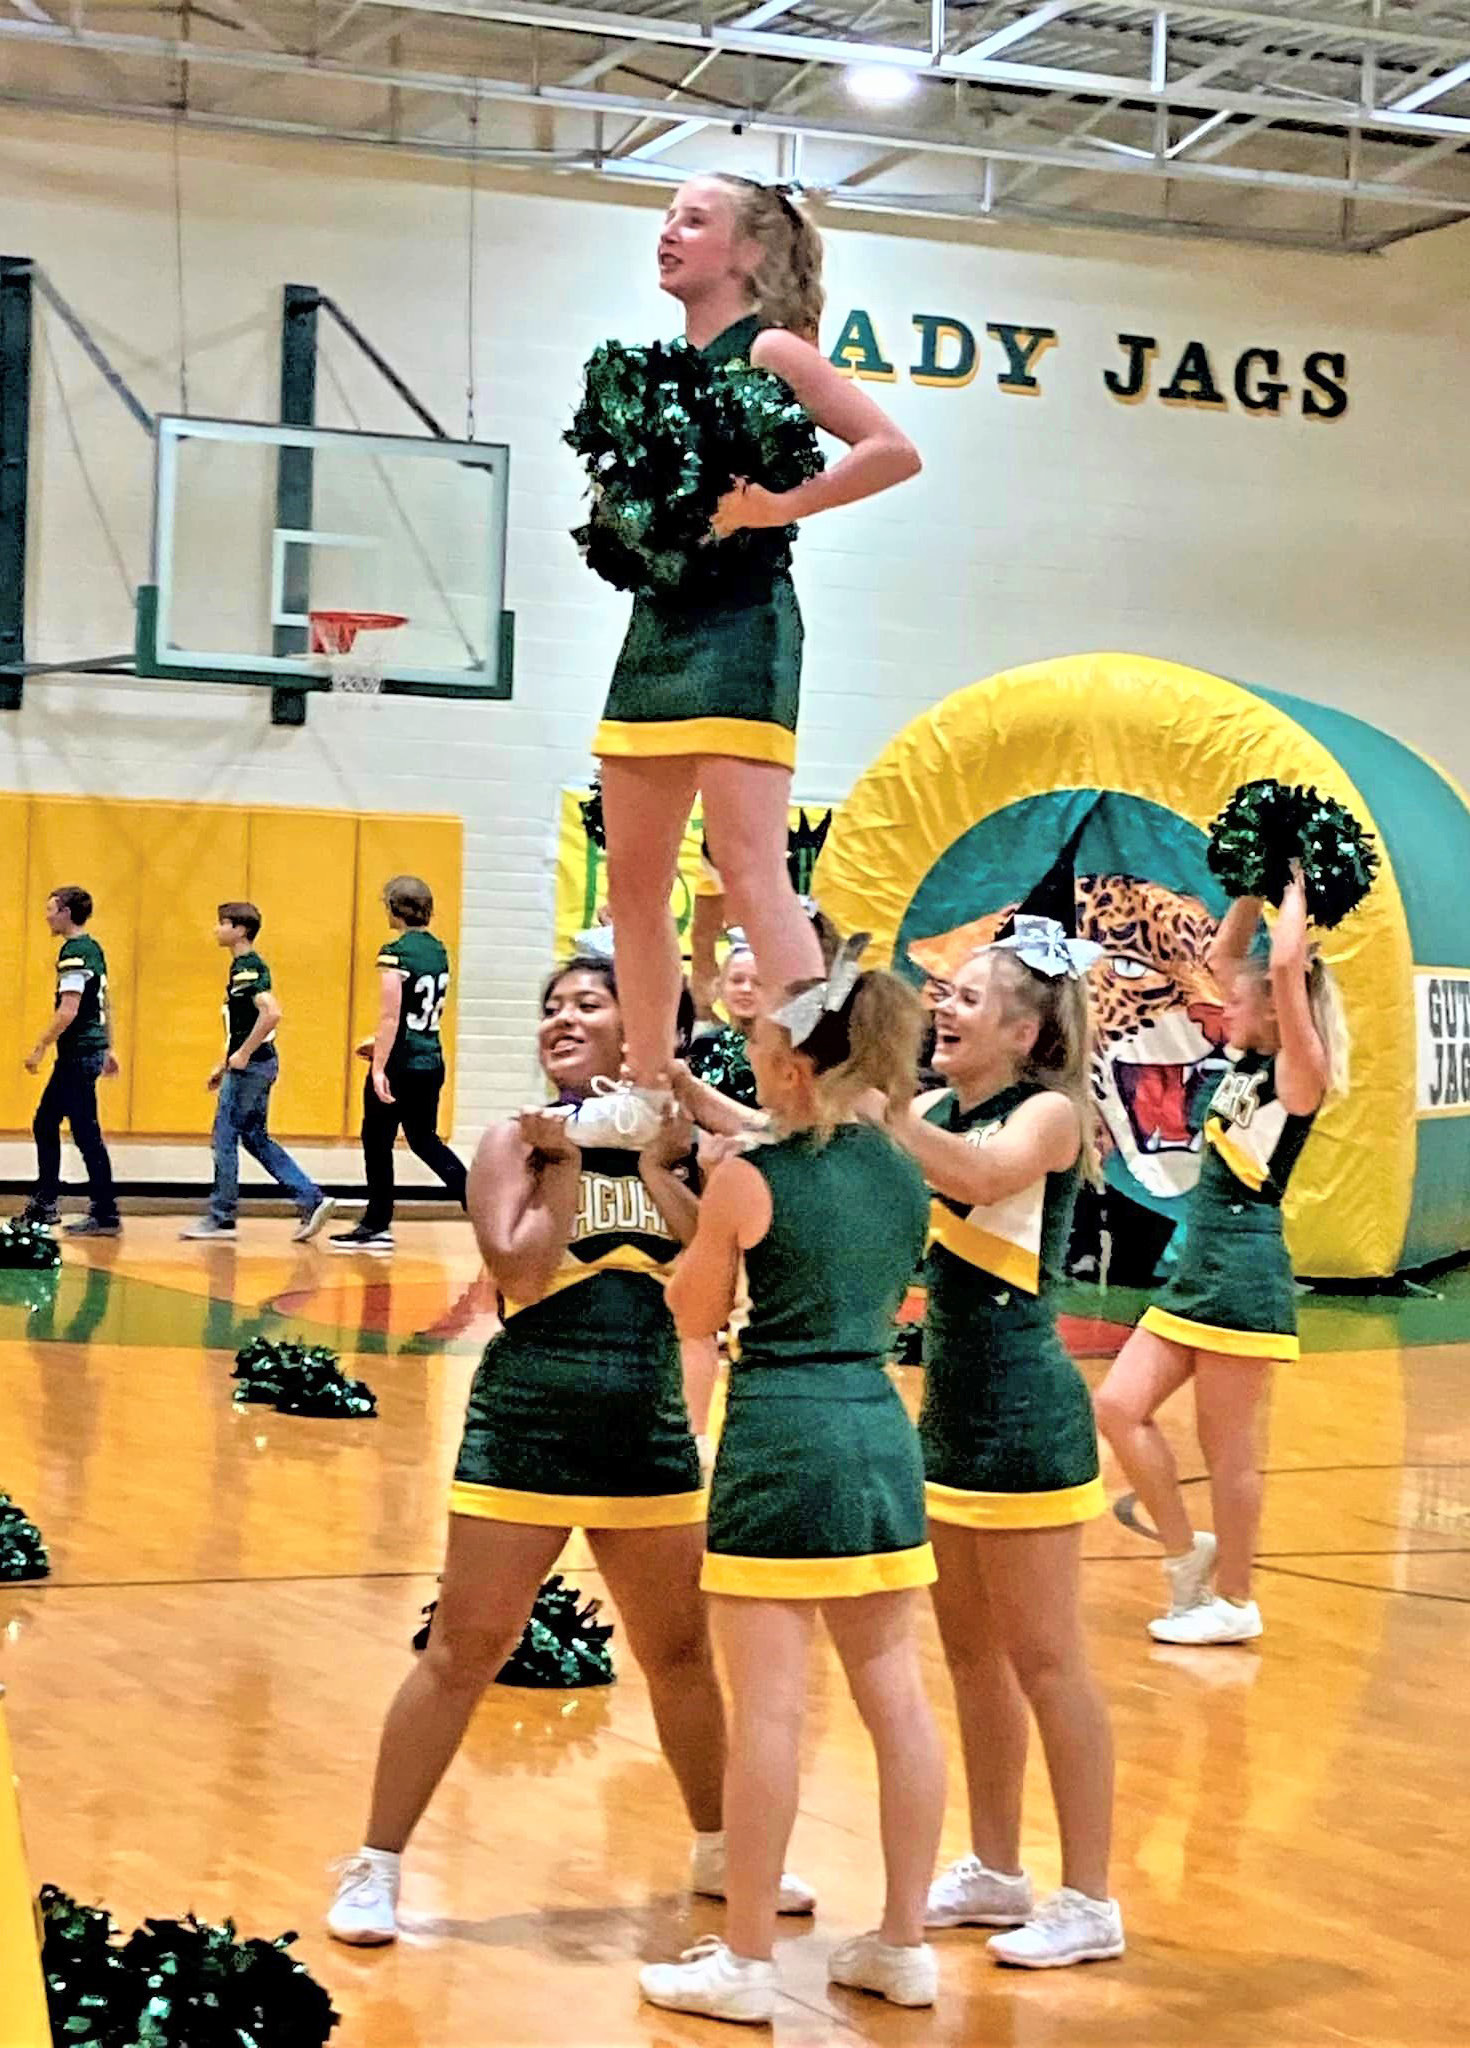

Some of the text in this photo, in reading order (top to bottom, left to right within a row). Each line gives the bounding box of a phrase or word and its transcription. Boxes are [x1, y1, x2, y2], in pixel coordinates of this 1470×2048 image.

[827, 309, 1348, 424] ADY JAGS
[406, 972, 450, 1031] 32
[1209, 1071, 1268, 1129] ARS
[571, 1171, 672, 1239] AGUA
